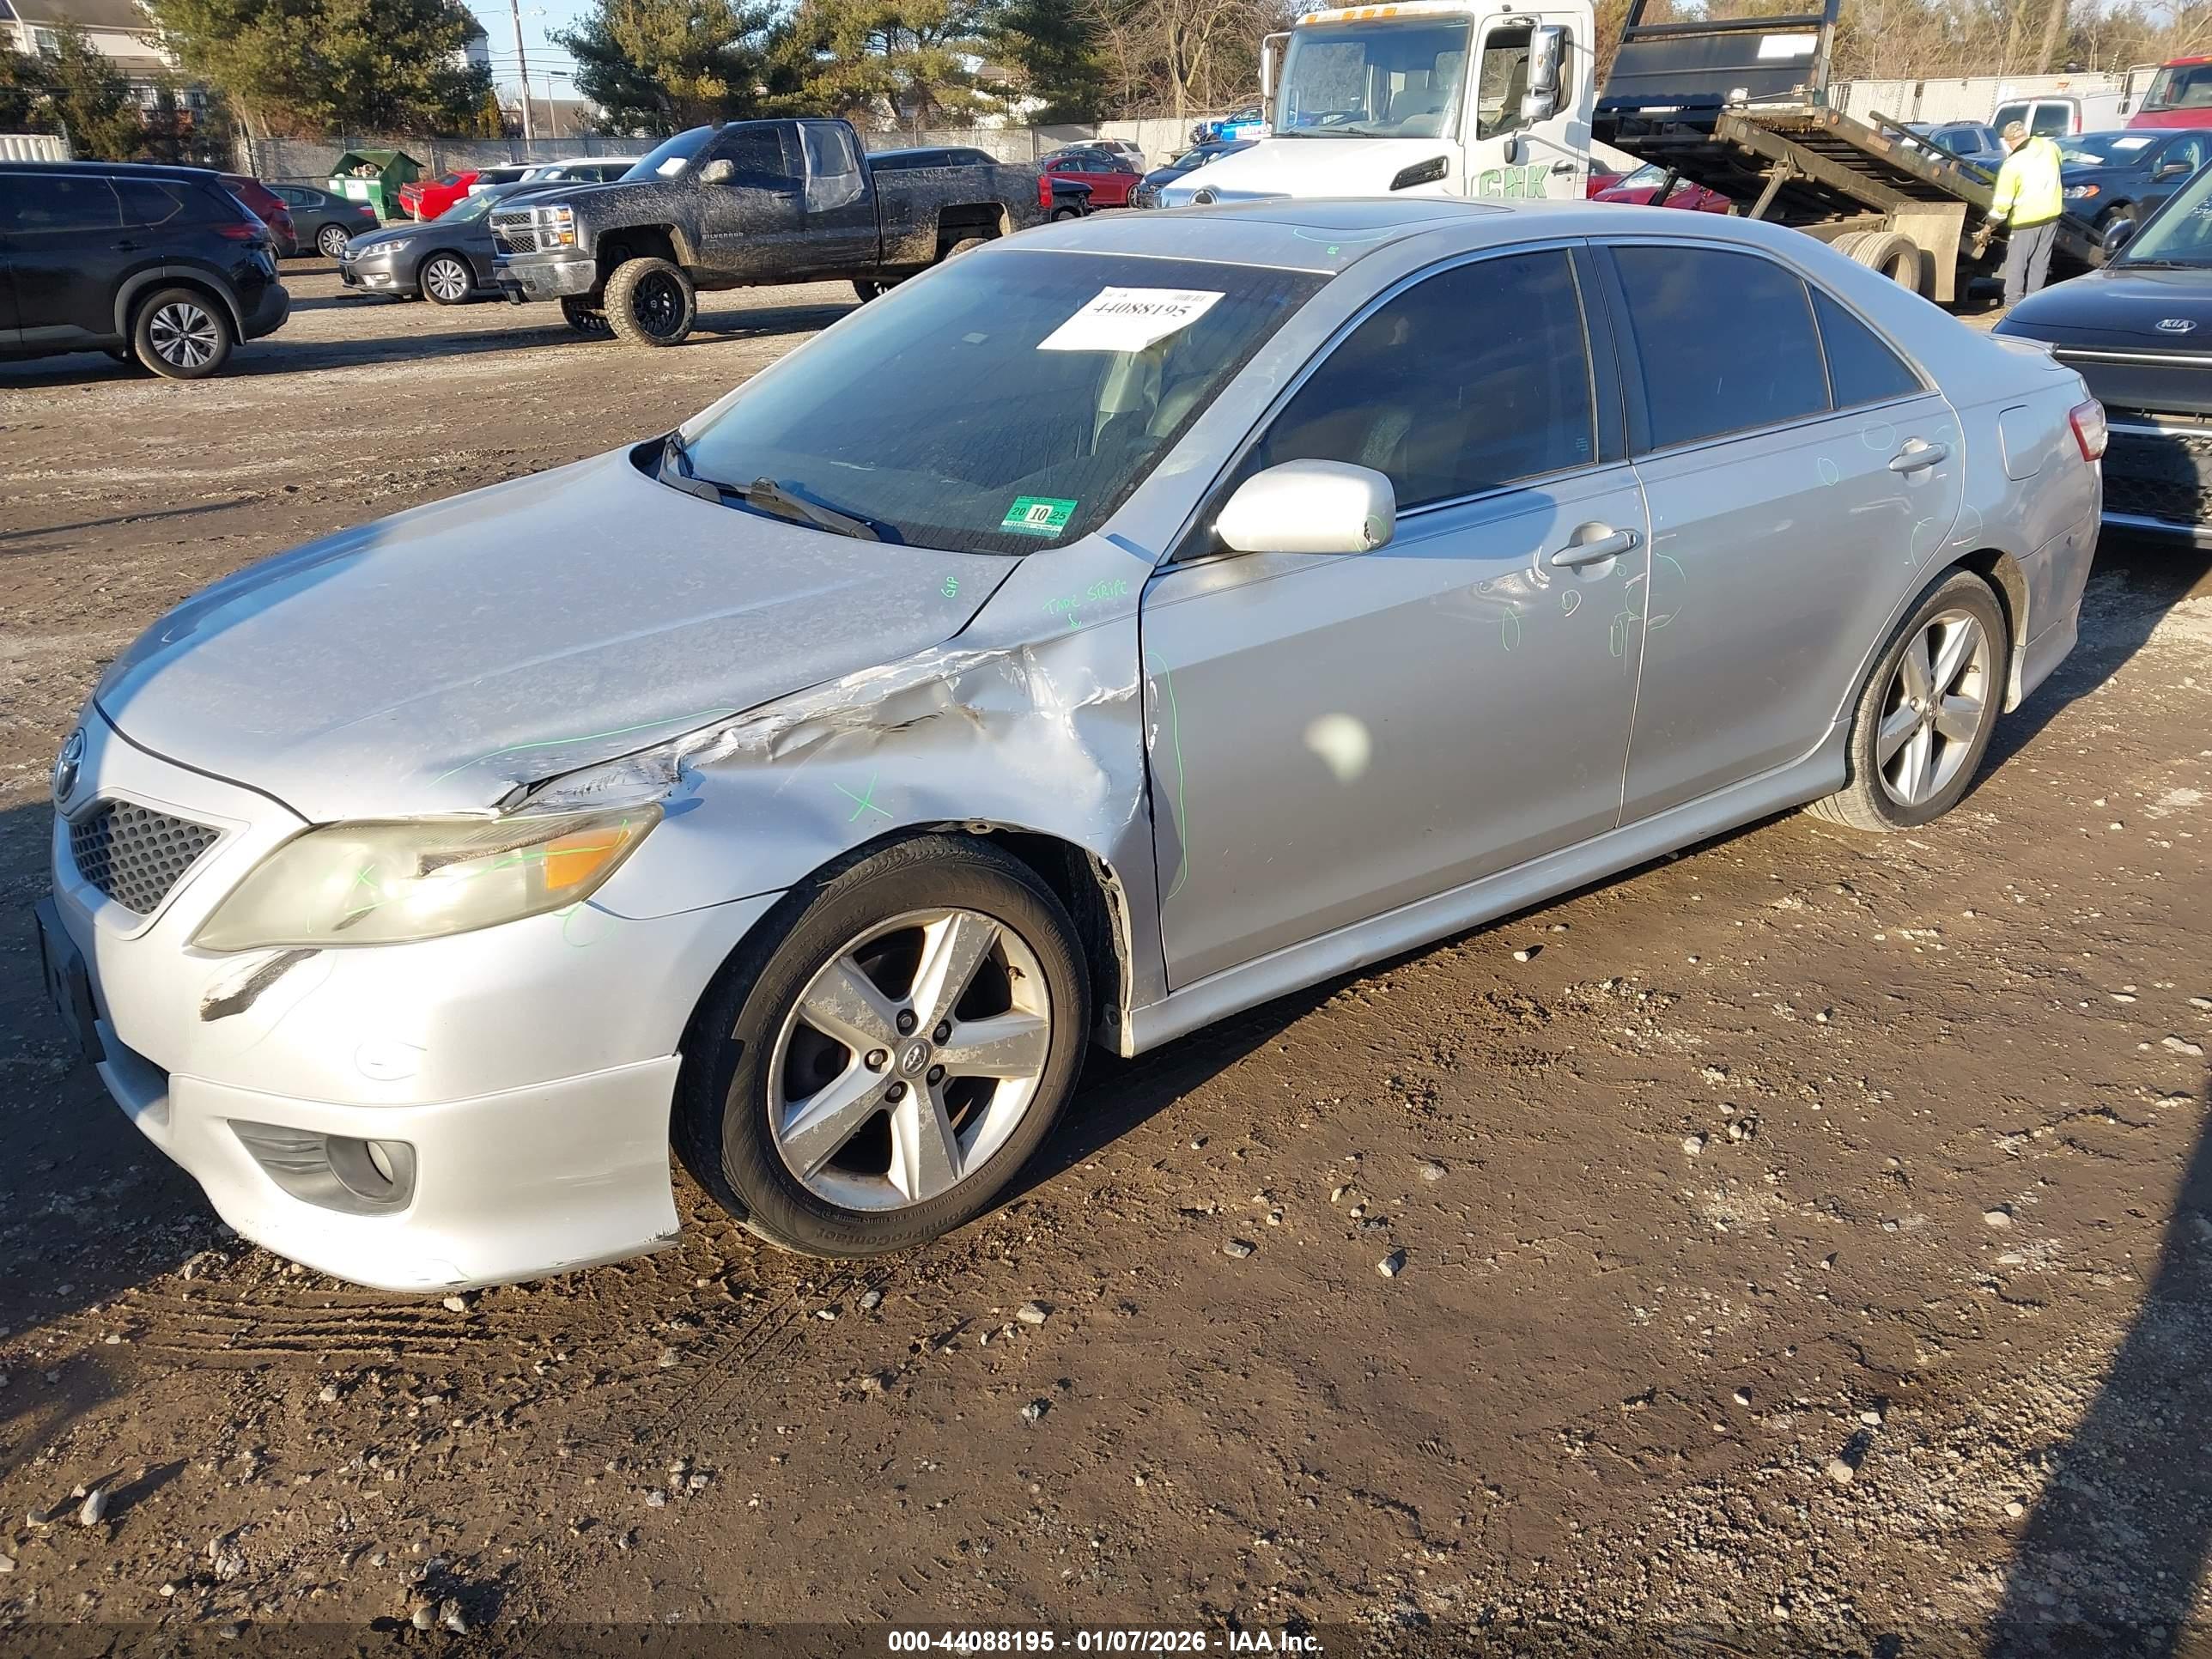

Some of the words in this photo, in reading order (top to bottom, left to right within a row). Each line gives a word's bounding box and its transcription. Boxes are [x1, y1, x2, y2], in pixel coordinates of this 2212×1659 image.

[1093, 302, 1193, 318] 44088195
[2160, 319, 2190, 328] KIA
[1011, 507, 1027, 516] 20
[1030, 507, 1048, 521] 10
[1048, 511, 1066, 520] 25
